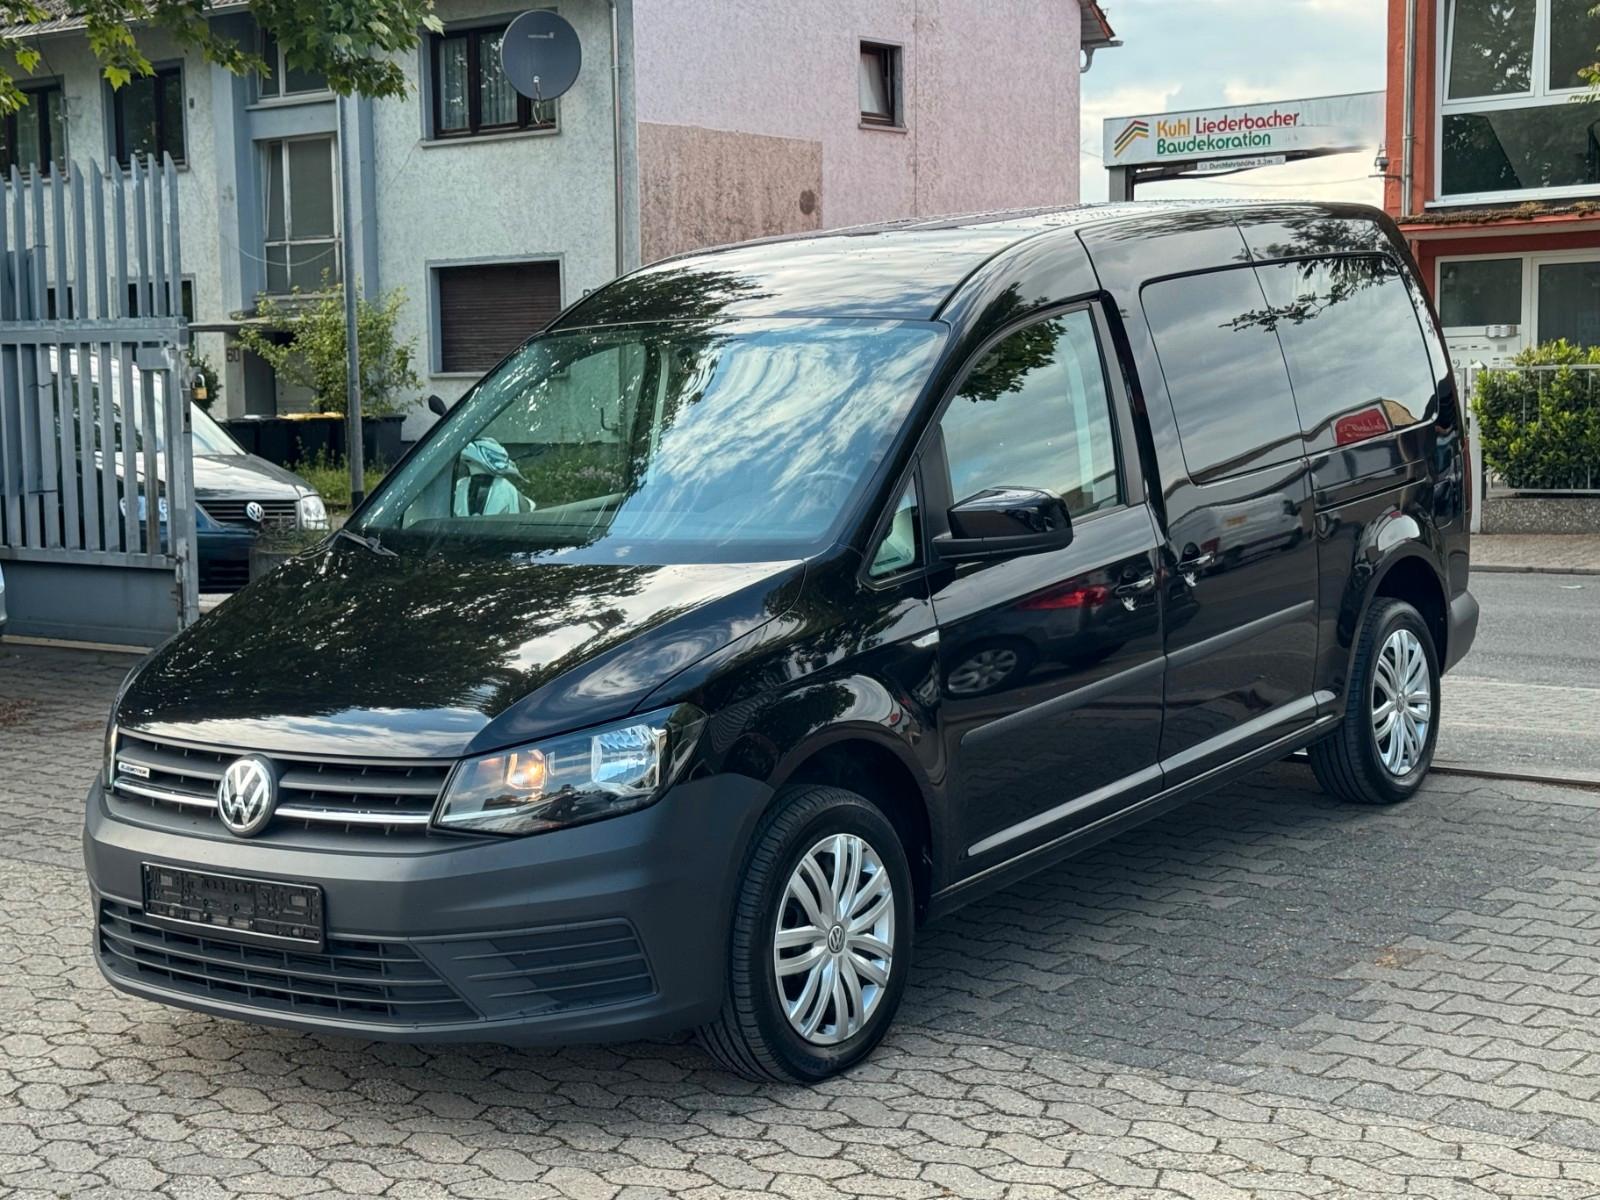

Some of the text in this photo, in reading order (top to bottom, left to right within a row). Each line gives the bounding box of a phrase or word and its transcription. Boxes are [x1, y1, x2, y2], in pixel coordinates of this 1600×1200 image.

[1157, 110, 1299, 137] Kuhl Liederbacher
[1157, 131, 1271, 154] Baudekoration
[221, 759, 271, 830] VW
